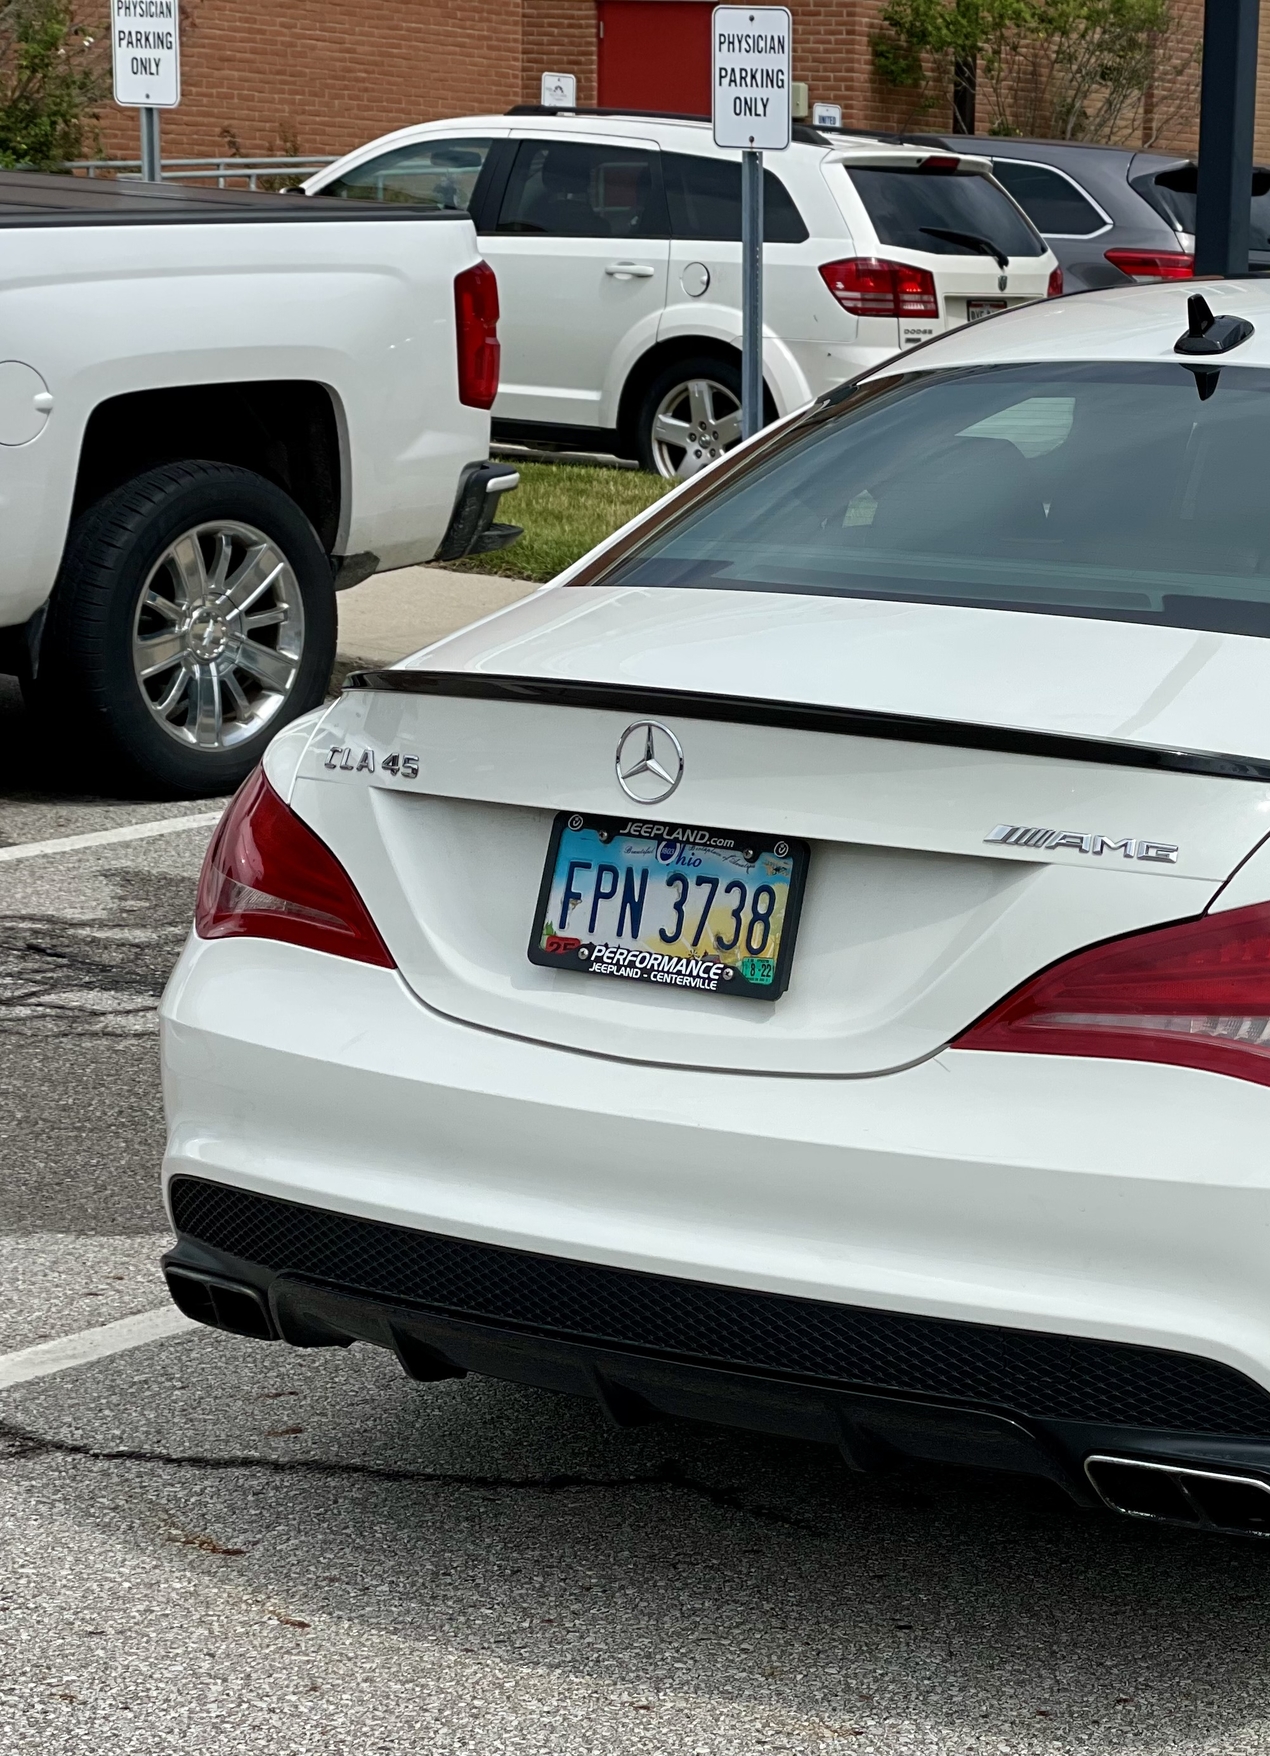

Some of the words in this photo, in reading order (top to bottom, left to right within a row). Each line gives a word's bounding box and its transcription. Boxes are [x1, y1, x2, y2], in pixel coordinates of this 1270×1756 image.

[117, 0, 172, 18] PHYSICIAN
[118, 30, 173, 50] PARKING
[718, 33, 785, 54] PHYSICIAN
[131, 56, 161, 76] ONLY
[718, 67, 785, 89] PARKING
[733, 96, 769, 117] ONLY
[381, 752, 419, 779] 45
[620, 821, 735, 848] JEEPLAND.com
[1045, 830, 1179, 864] AMG
[558, 861, 649, 940] FPN
[659, 871, 777, 956] 3738
[591, 946, 724, 980] PERFORMANCE
[589, 961, 641, 979] JEEPLAND
[650, 972, 718, 991] CENTERVILLE
